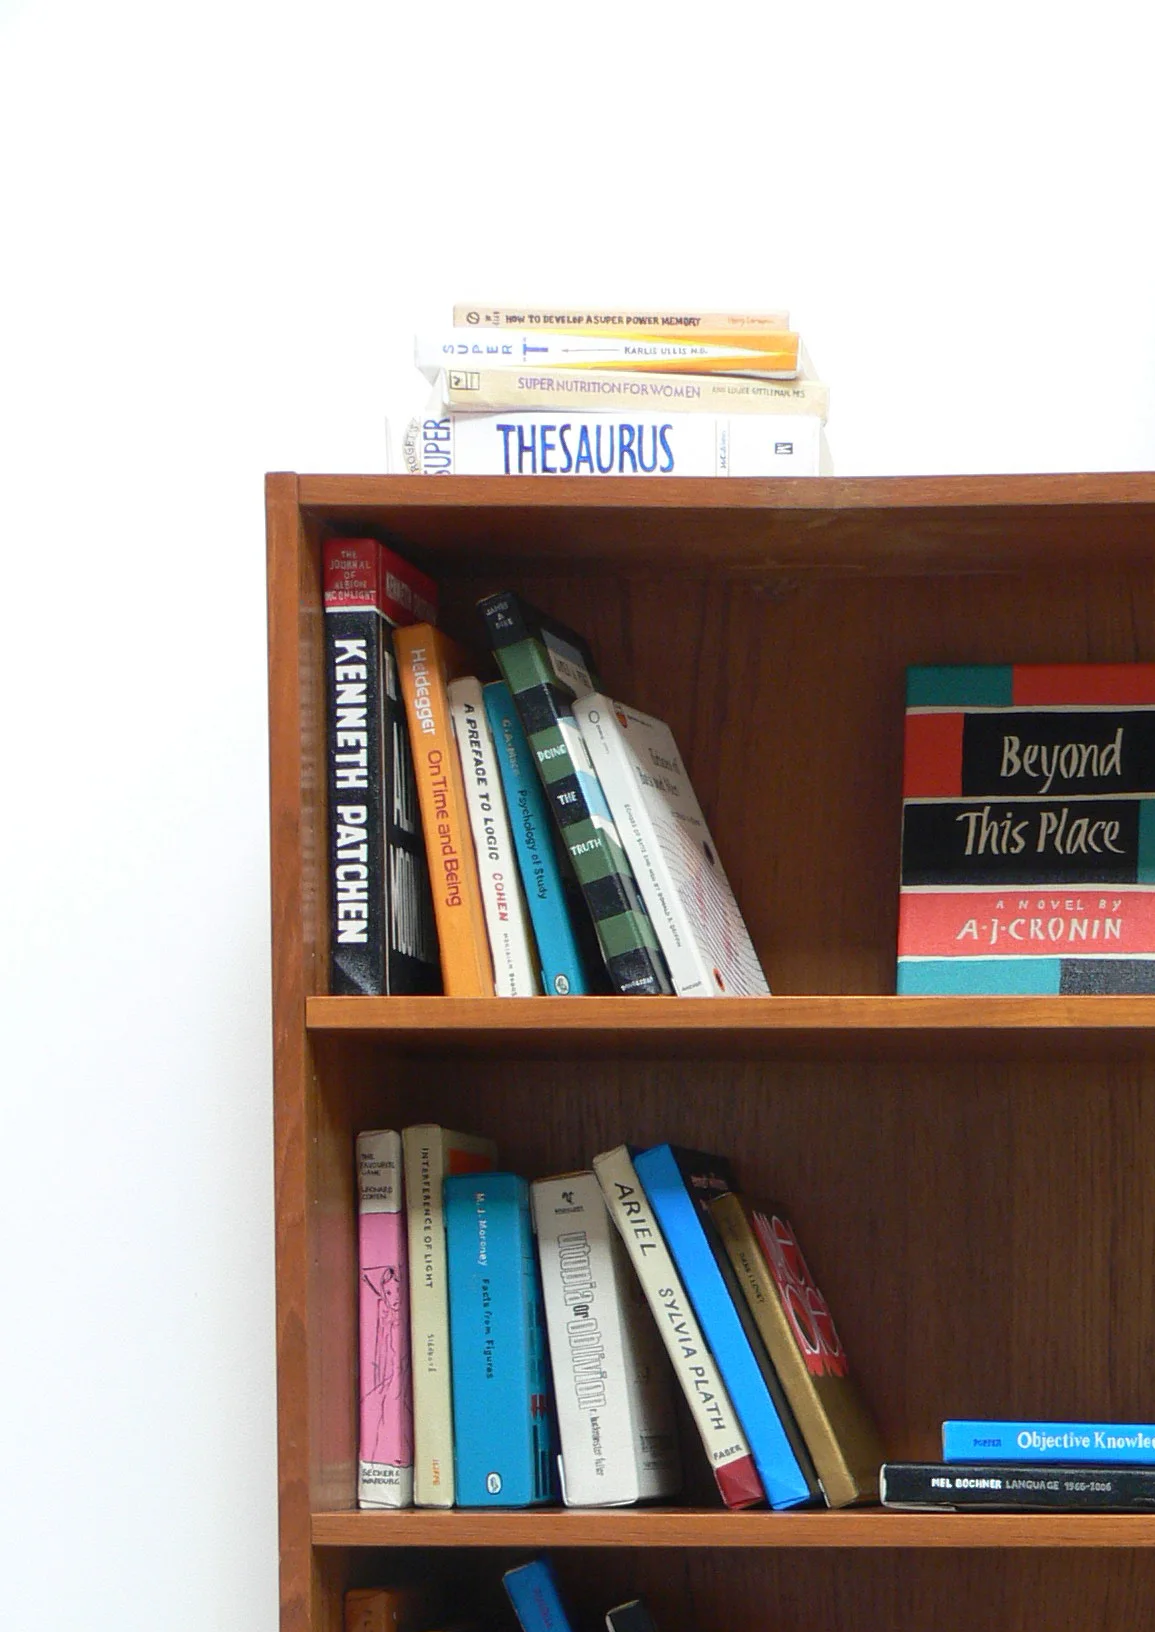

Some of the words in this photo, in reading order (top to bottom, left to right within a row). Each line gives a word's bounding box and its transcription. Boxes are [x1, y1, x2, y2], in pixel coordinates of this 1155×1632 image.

[506, 315, 526, 325] HOW
[529, 315, 541, 325] TO
[543, 315, 584, 325] DEVELOP
[626, 315, 660, 326] POWER
[661, 316, 702, 328] MEMORY
[517, 376, 554, 392] SUPER
[556, 379, 622, 395] NUTRITION
[623, 382, 649, 395] FOR
[650, 384, 701, 399] WOMEN
[496, 422, 675, 477] THESAURUS
[410, 647, 438, 737] Heidegger
[464, 703, 475, 714] A
[334, 637, 369, 791] KENNETH
[427, 748, 443, 772] On
[465, 718, 488, 787] PREFACE
[535, 743, 568, 763] DOING
[999, 727, 1123, 795] Beyond
[427, 774, 449, 818] Time
[478, 792, 492, 812] TO
[556, 790, 578, 806] THE
[517, 789, 538, 852] Psychology
[956, 805, 1026, 857] This
[1035, 811, 1127, 856] Place
[437, 821, 456, 857] and
[482, 817, 500, 862] LOGIC
[570, 838, 603, 857] TRUTH
[334, 804, 369, 945] PATCHEN
[531, 854, 543, 866] of
[443, 859, 462, 908] Being
[492, 872, 510, 923] COHEN
[532, 866, 549, 901] Study
[995, 899, 1006, 911] A
[1018, 898, 1086, 912] NOVEL
[1098, 898, 1123, 913] BY
[420, 1147, 433, 1232] INTERFERENCE
[614, 1182, 657, 1257] ARIEL
[424, 1235, 433, 1250] OF
[424, 1253, 434, 1289] LIGHT
[483, 1310, 492, 1337] from
[572, 1304, 590, 1319] or
[658, 1287, 699, 1360] SYLVIA
[688, 1365, 727, 1431] PLATH
[712, 1443, 744, 1461] FABER
[1016, 1430, 1091, 1452] Objective
[931, 1477, 953, 1489] MEL
[954, 1478, 1002, 1490] BOCHNER
[1005, 1480, 1060, 1491] LANGUAGE
